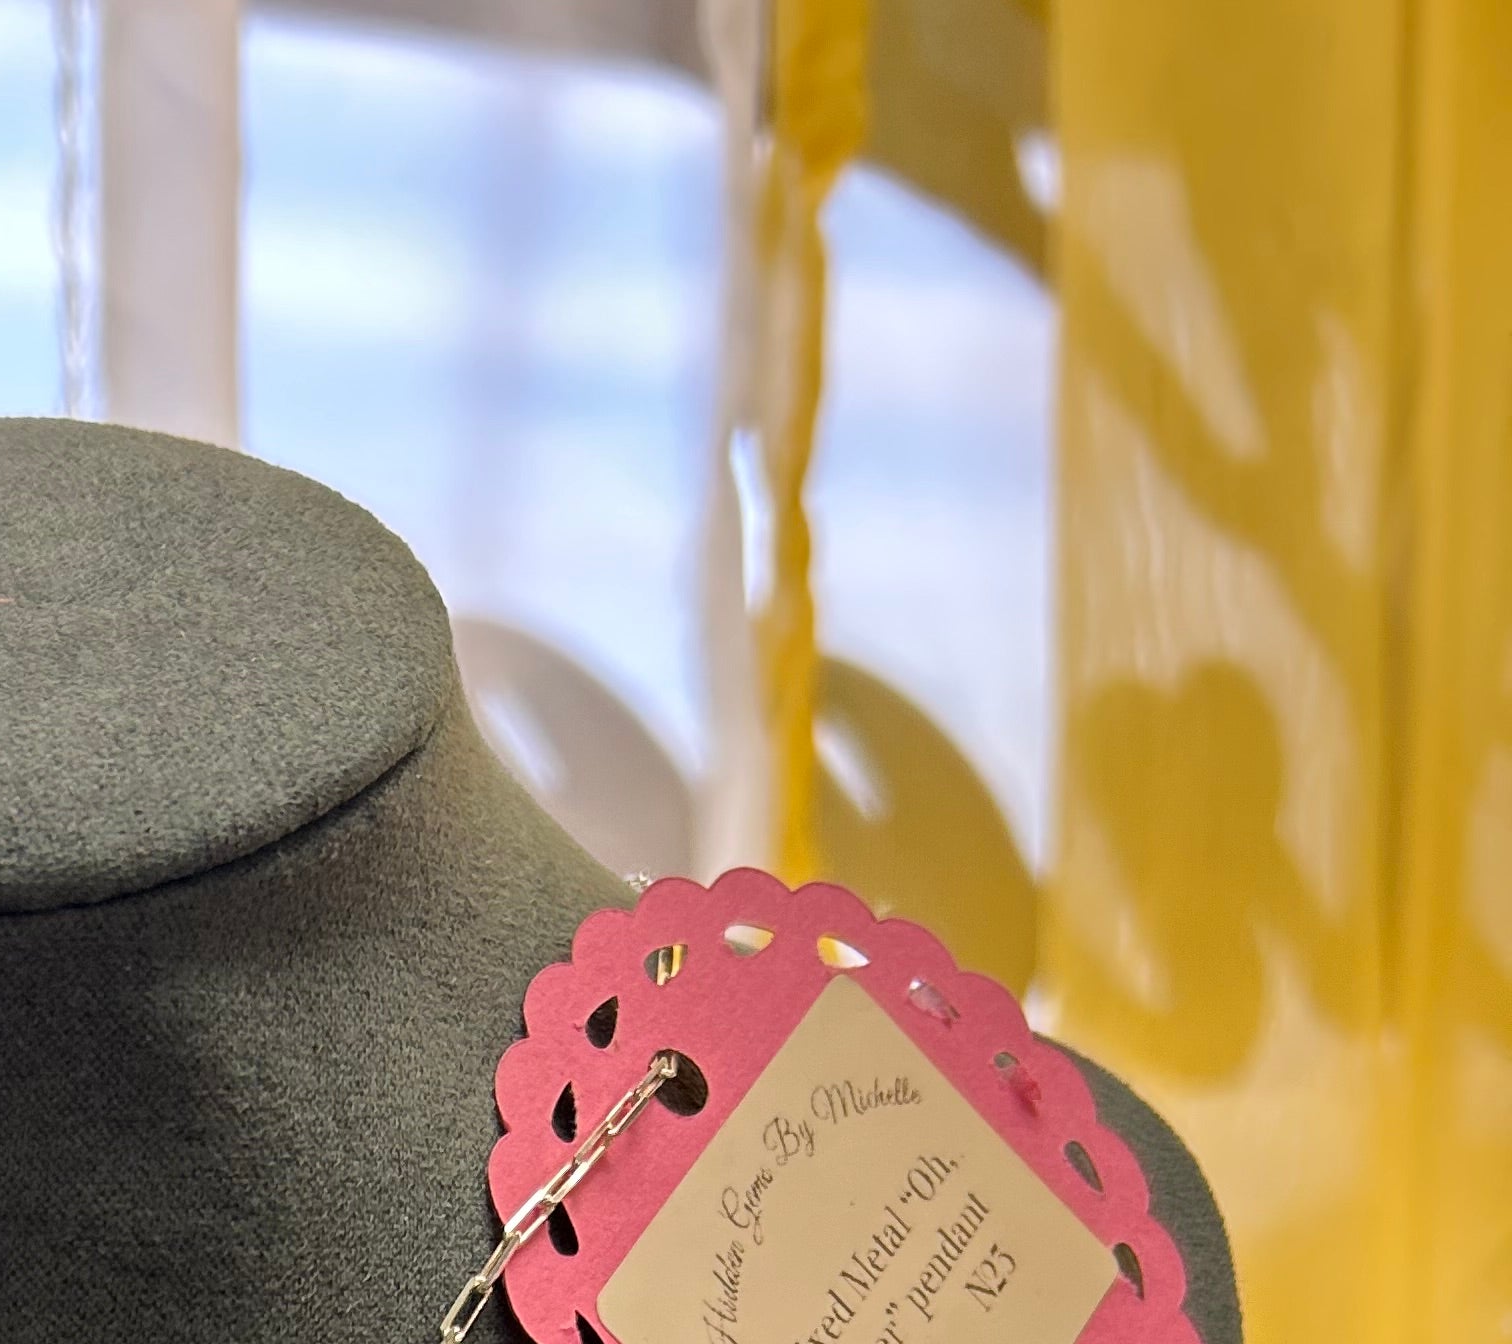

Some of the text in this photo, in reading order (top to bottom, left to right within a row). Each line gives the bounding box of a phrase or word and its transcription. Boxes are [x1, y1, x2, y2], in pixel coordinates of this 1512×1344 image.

[718, 1167, 774, 1246] Gems
[762, 1115, 816, 1166] By
[810, 1076, 923, 1125] Michelle
[839, 1205, 913, 1302] Metal
[905, 1190, 991, 1323] pendant
